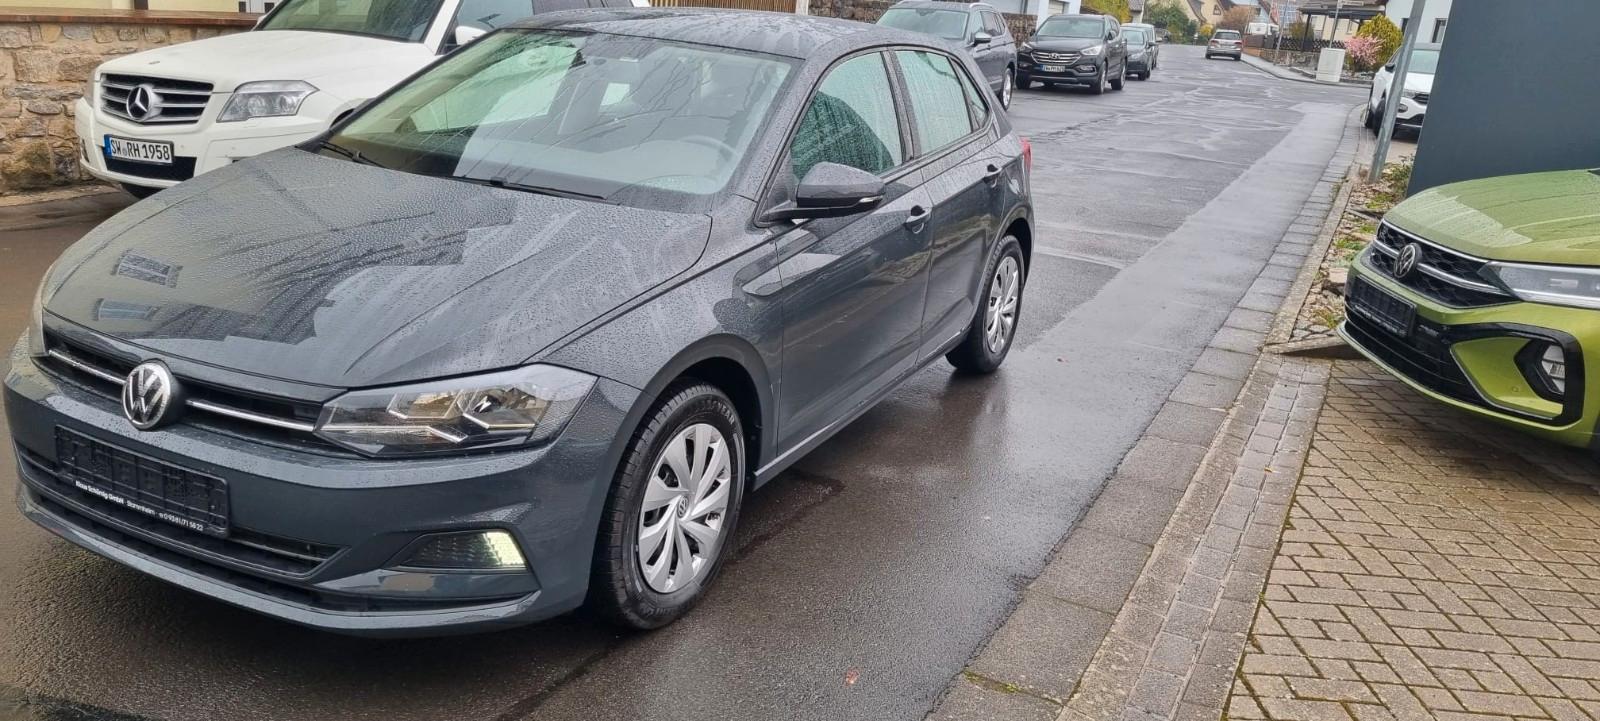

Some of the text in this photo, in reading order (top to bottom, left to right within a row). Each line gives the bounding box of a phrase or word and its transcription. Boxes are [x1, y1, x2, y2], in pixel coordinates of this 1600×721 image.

[111, 139, 170, 160] SW RH 1958
[123, 363, 170, 429] VW
[108, 493, 124, 504] GmbH
